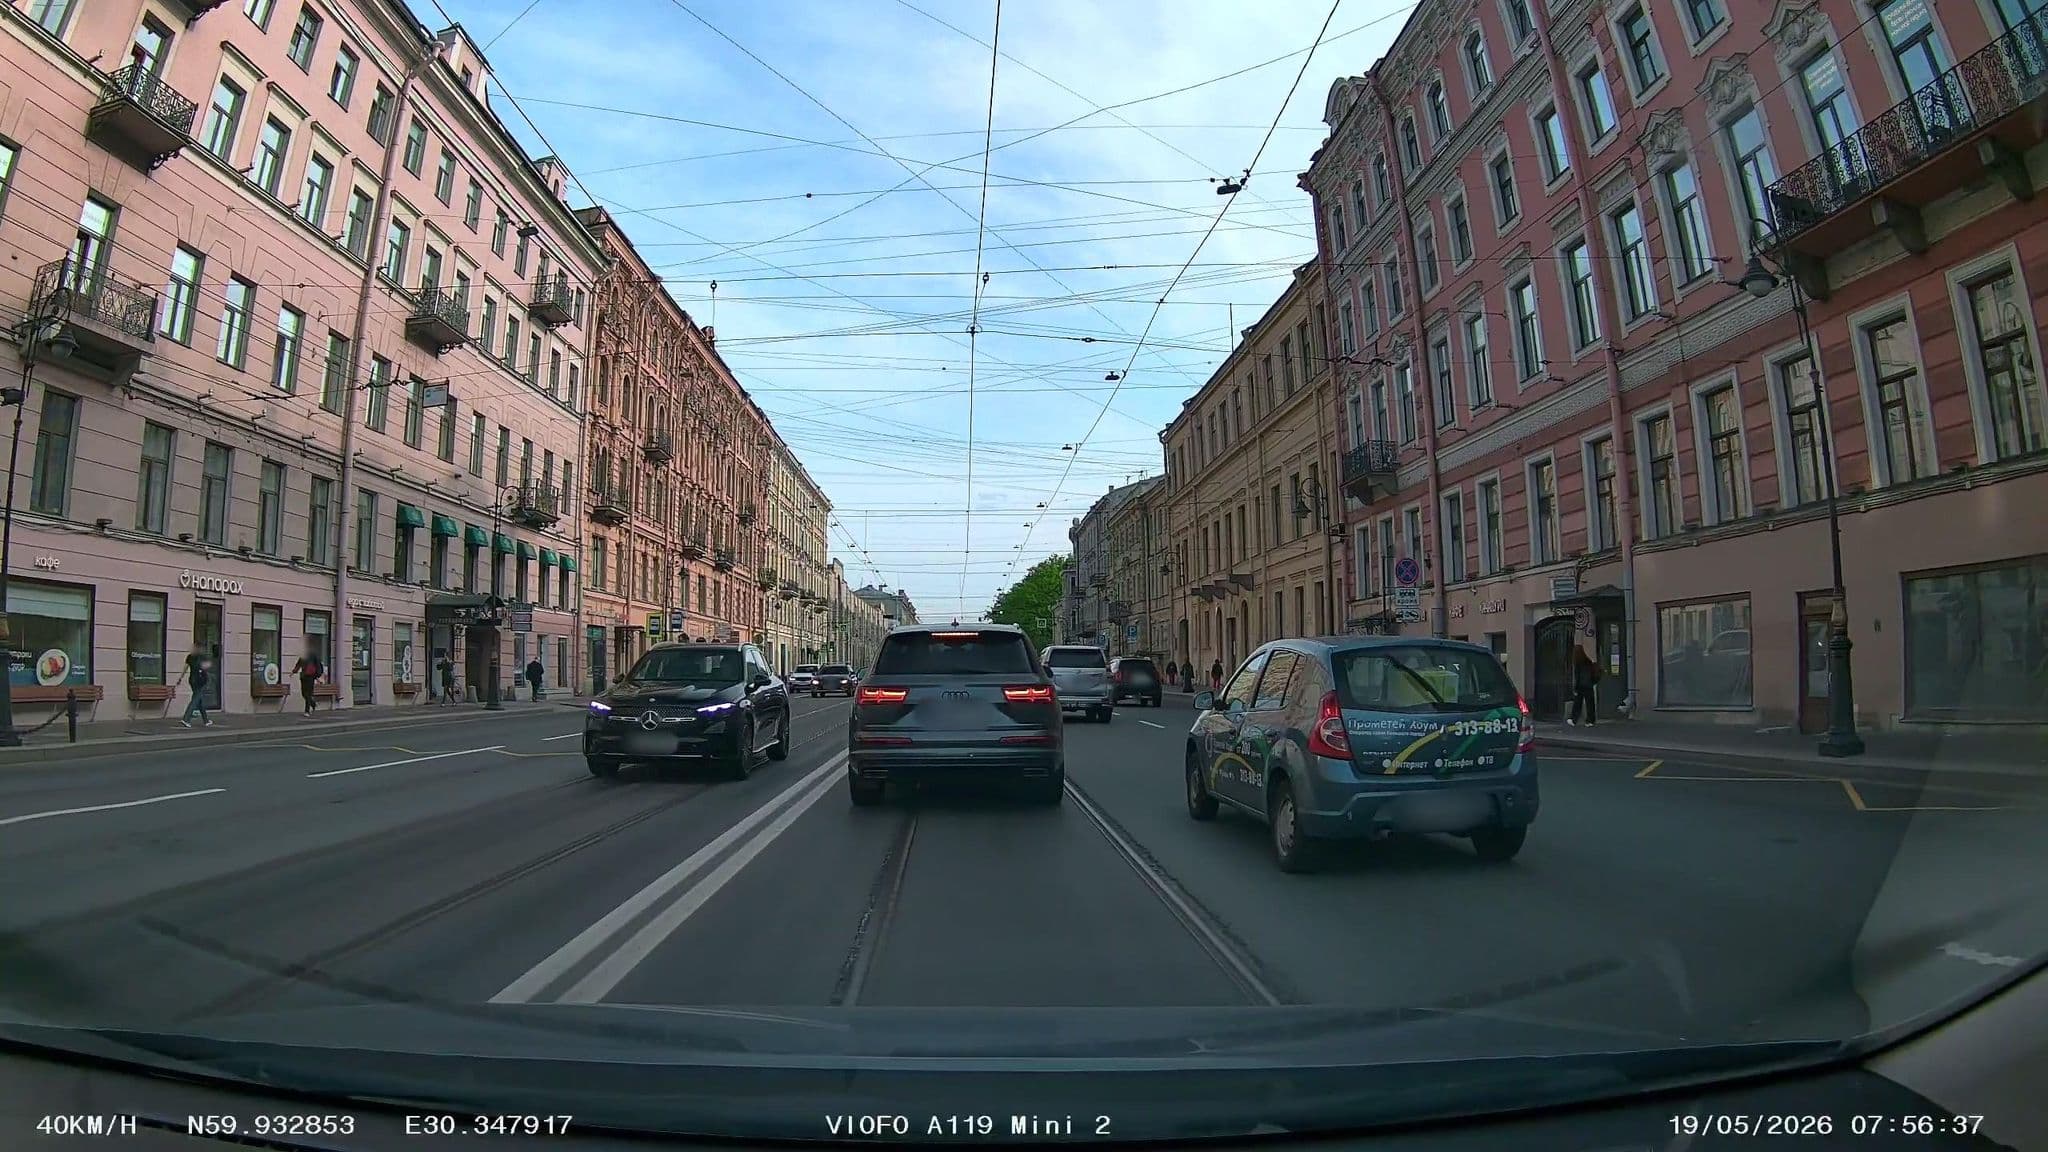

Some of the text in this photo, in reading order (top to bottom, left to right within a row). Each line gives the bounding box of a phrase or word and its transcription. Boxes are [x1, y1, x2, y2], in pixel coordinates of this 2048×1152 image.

[34, 556, 61, 570] кафе
[1129, 626, 1136, 637] P
[1348, 717, 1406, 730] Прометей
[1454, 718, 1520, 737] 313-88-13
